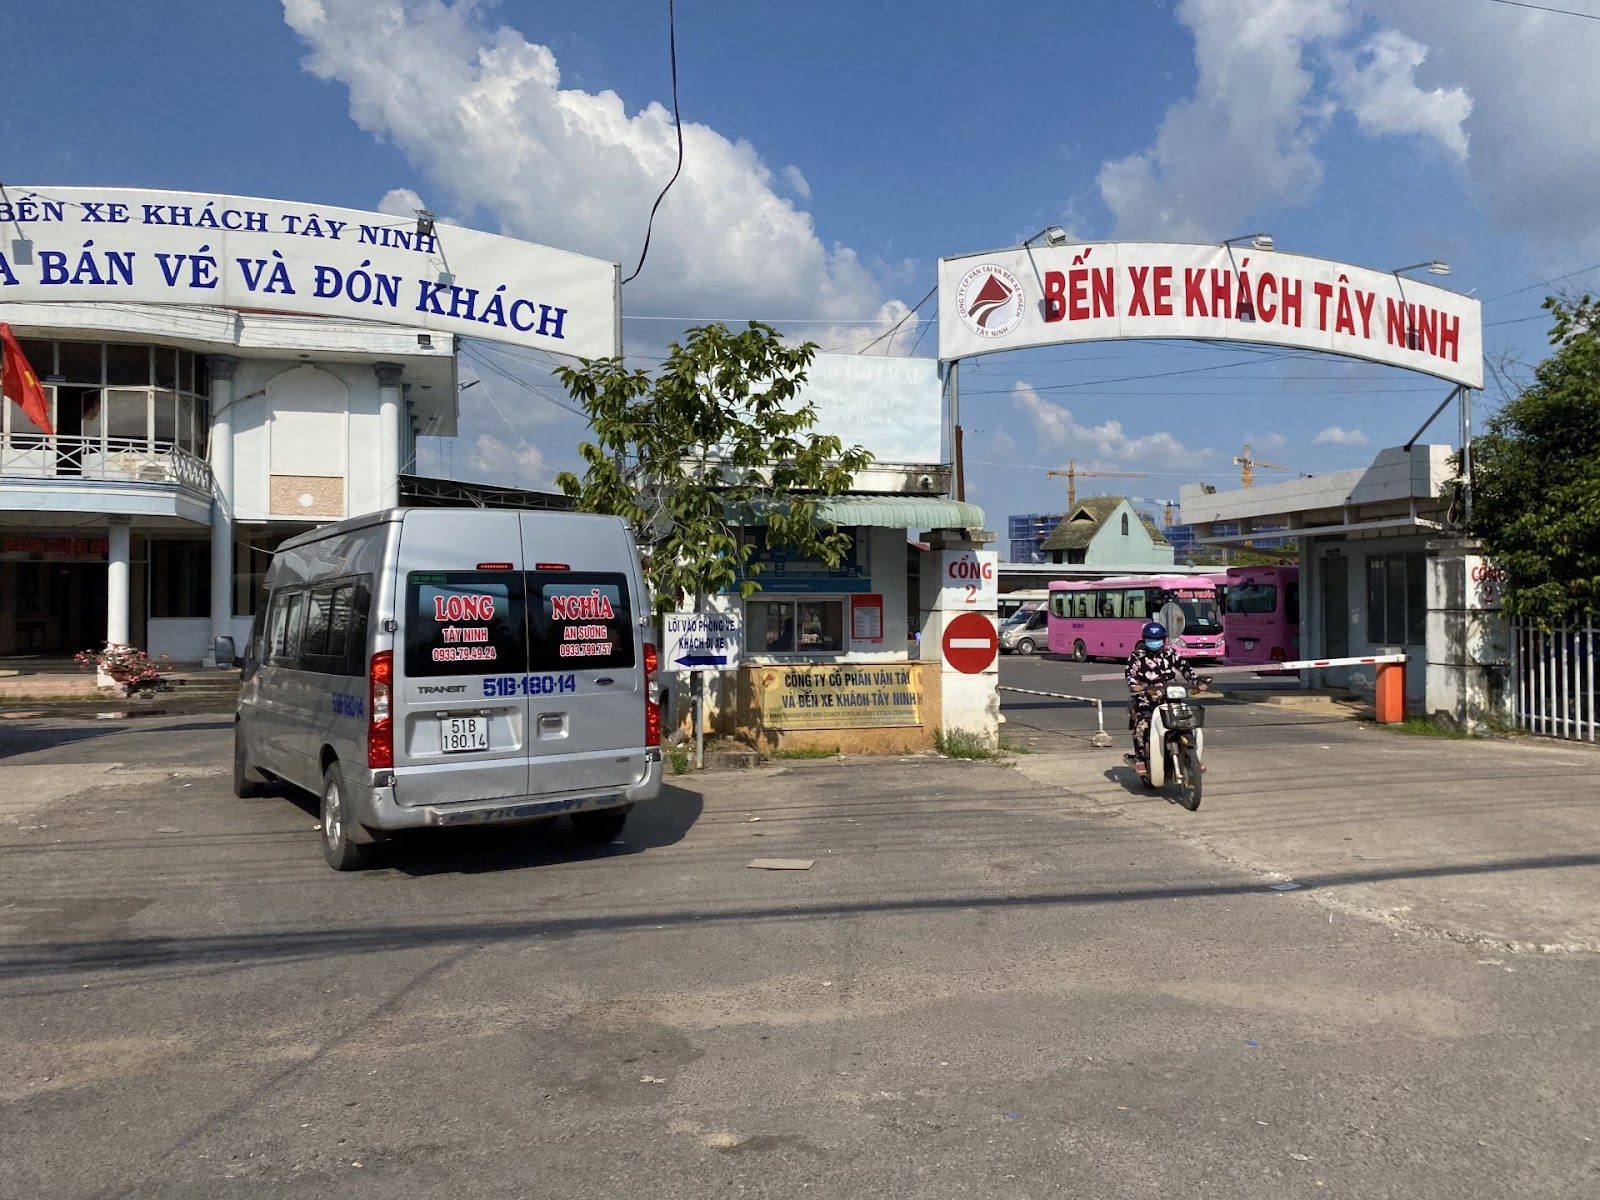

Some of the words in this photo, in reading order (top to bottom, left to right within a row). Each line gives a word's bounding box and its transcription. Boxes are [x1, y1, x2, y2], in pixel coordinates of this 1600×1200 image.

[0, 193, 65, 222] BẾN
[80, 202, 130, 223] XE
[142, 202, 269, 232] KHÁCH
[281, 213, 347, 240] TÂY
[358, 225, 436, 253] NINH
[38, 240, 135, 285] BÁN
[154, 245, 219, 288] VÉ
[236, 250, 295, 294] VÀ
[313, 260, 402, 307] ĐÓN
[415, 279, 568, 339] KHÁCH
[1045, 248, 1114, 323] BẾN
[1128, 266, 1173, 316] XE
[1185, 258, 1302, 328] KHÁCH
[1314, 274, 1375, 339] TÂY
[1387, 297, 1460, 363] NINH
[991, 326, 1009, 337] NINH
[948, 554, 992, 580] CỔNG
[965, 584, 977, 604] 2
[434, 595, 494, 621] LONG
[551, 588, 614, 620] NGHĨA
[668, 616, 680, 632] LỐI
[682, 618, 697, 632] VÀO
[442, 626, 461, 643] TÂY
[463, 627, 488, 642] NINH
[564, 626, 577, 640] AN
[560, 643, 612, 657] 0933.799.757
[679, 635, 704, 649] KHÁCH
[715, 638, 724, 649] XE
[432, 646, 497, 661] 0933.79.49.24
[785, 671, 812, 687] CÔNG
[815, 673, 826, 687] TY
[829, 668, 842, 687] CỔ
[873, 669, 893, 688] VẬN
[417, 685, 467, 694] TRANSIT
[782, 692, 796, 708] VÀ
[798, 690, 818, 708] BẾN
[820, 693, 834, 707] XE
[836, 690, 870, 708] KHÁCH
[871, 690, 890, 706] TÂY
[452, 719, 476, 734] 51B
[443, 734, 486, 750] 180.14
